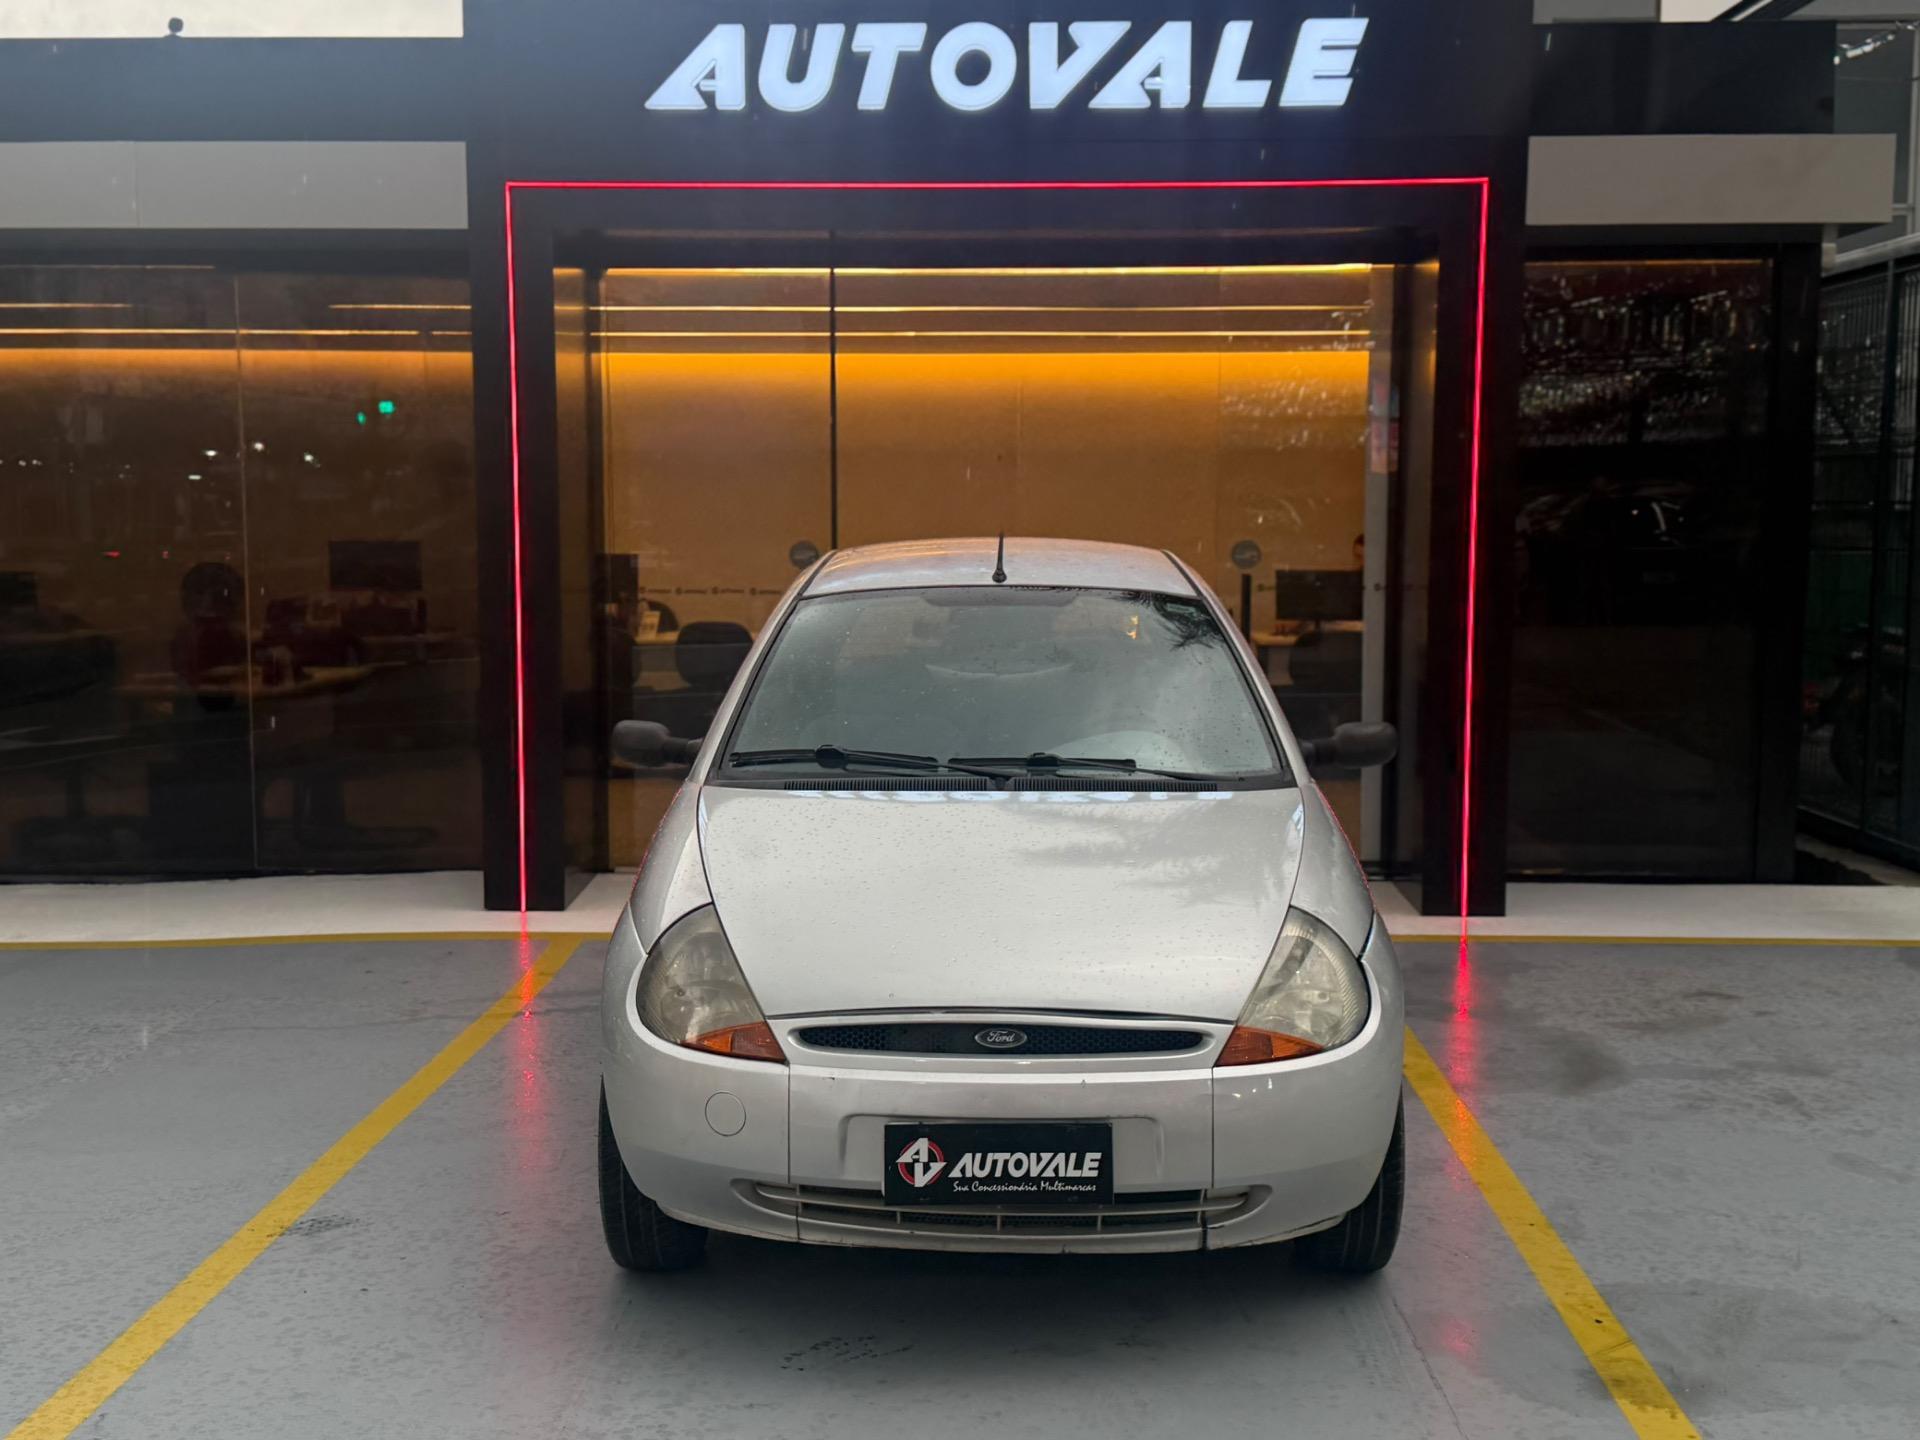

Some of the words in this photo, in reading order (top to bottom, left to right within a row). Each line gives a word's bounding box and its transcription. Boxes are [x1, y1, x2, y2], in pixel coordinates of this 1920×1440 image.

[645, 18, 1369, 112] AUTOVALE
[986, 1030, 1016, 1042] Ford
[947, 1152, 1102, 1178] AUTOVALE
[953, 1180, 969, 1192] Sua
[971, 1180, 1038, 1192] Concessionária
[1040, 1180, 1097, 1192] Multimarcas
